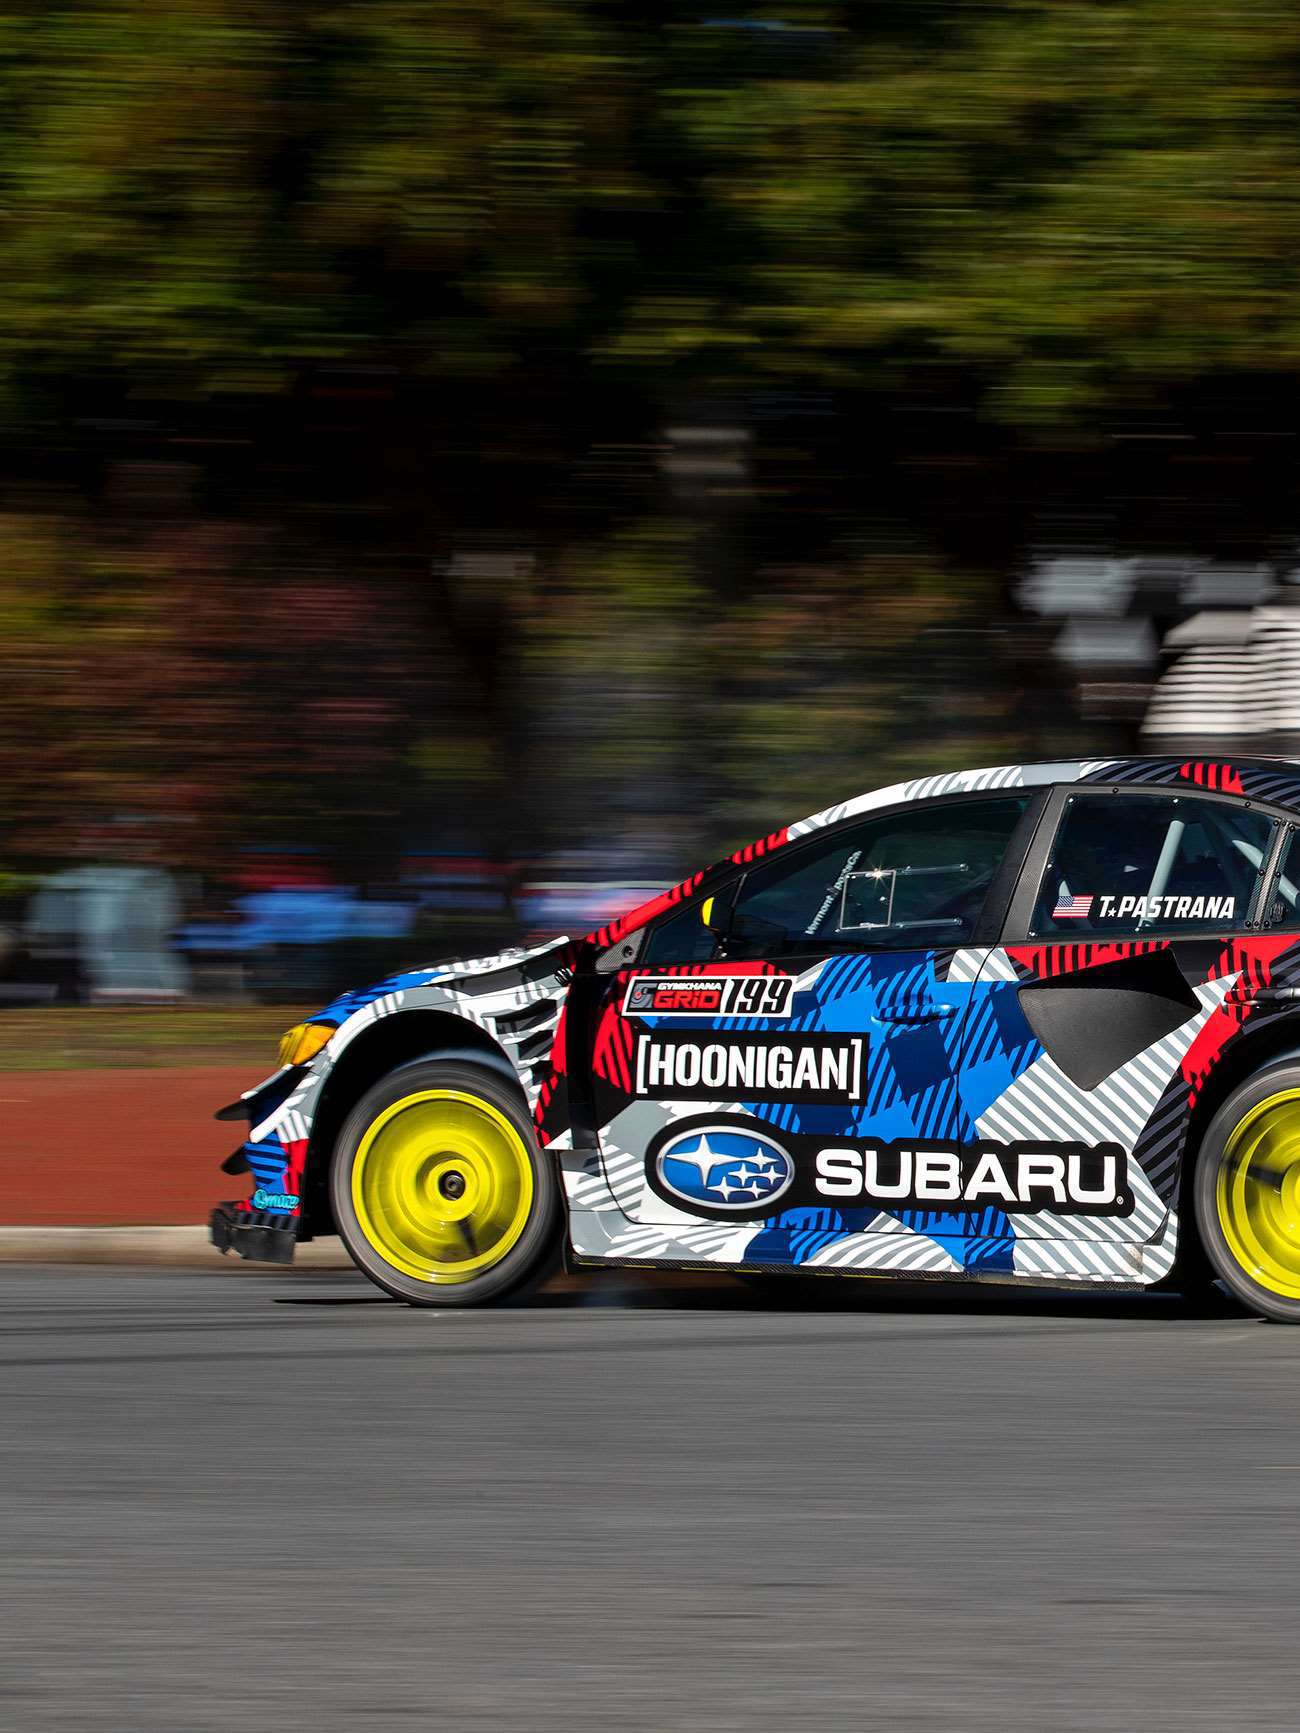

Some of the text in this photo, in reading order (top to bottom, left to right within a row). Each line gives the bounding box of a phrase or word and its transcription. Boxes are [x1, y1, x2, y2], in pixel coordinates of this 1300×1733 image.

[804, 895, 835, 935] Vermont
[657, 982, 723, 990] GYMKHANA
[724, 978, 793, 1014] 199
[815, 1148, 1117, 1205] SUBARU
